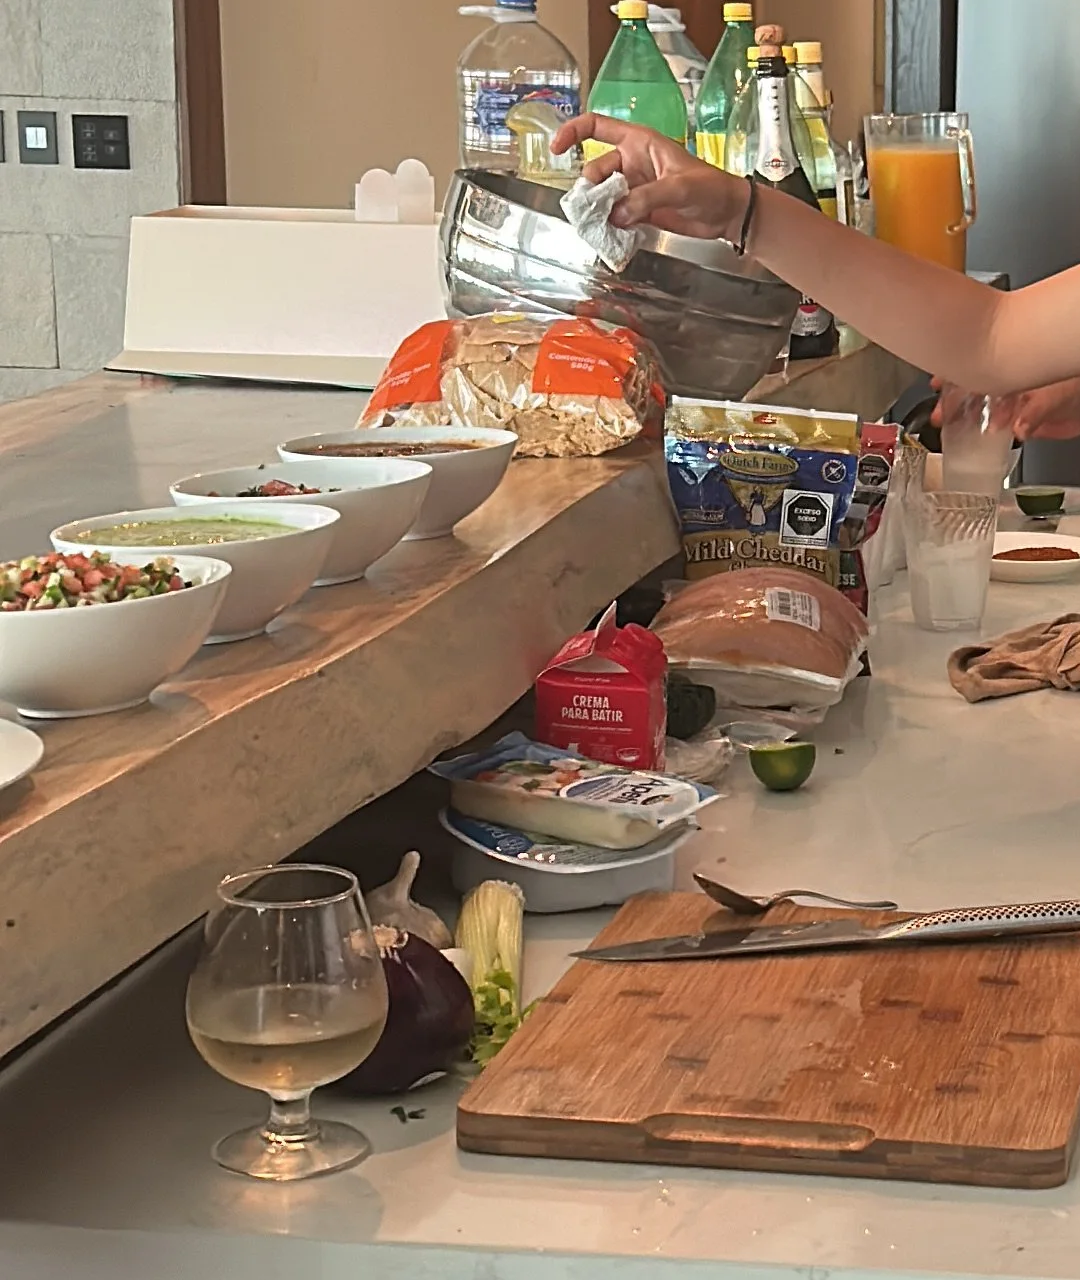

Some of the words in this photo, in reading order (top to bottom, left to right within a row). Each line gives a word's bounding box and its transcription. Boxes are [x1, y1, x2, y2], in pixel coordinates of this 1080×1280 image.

[685, 537, 730, 562] Mild
[736, 535, 827, 573] Cheddar
[572, 694, 610, 709] CREMA
[561, 707, 590, 720] PARA
[591, 709, 624, 722] BATIR
